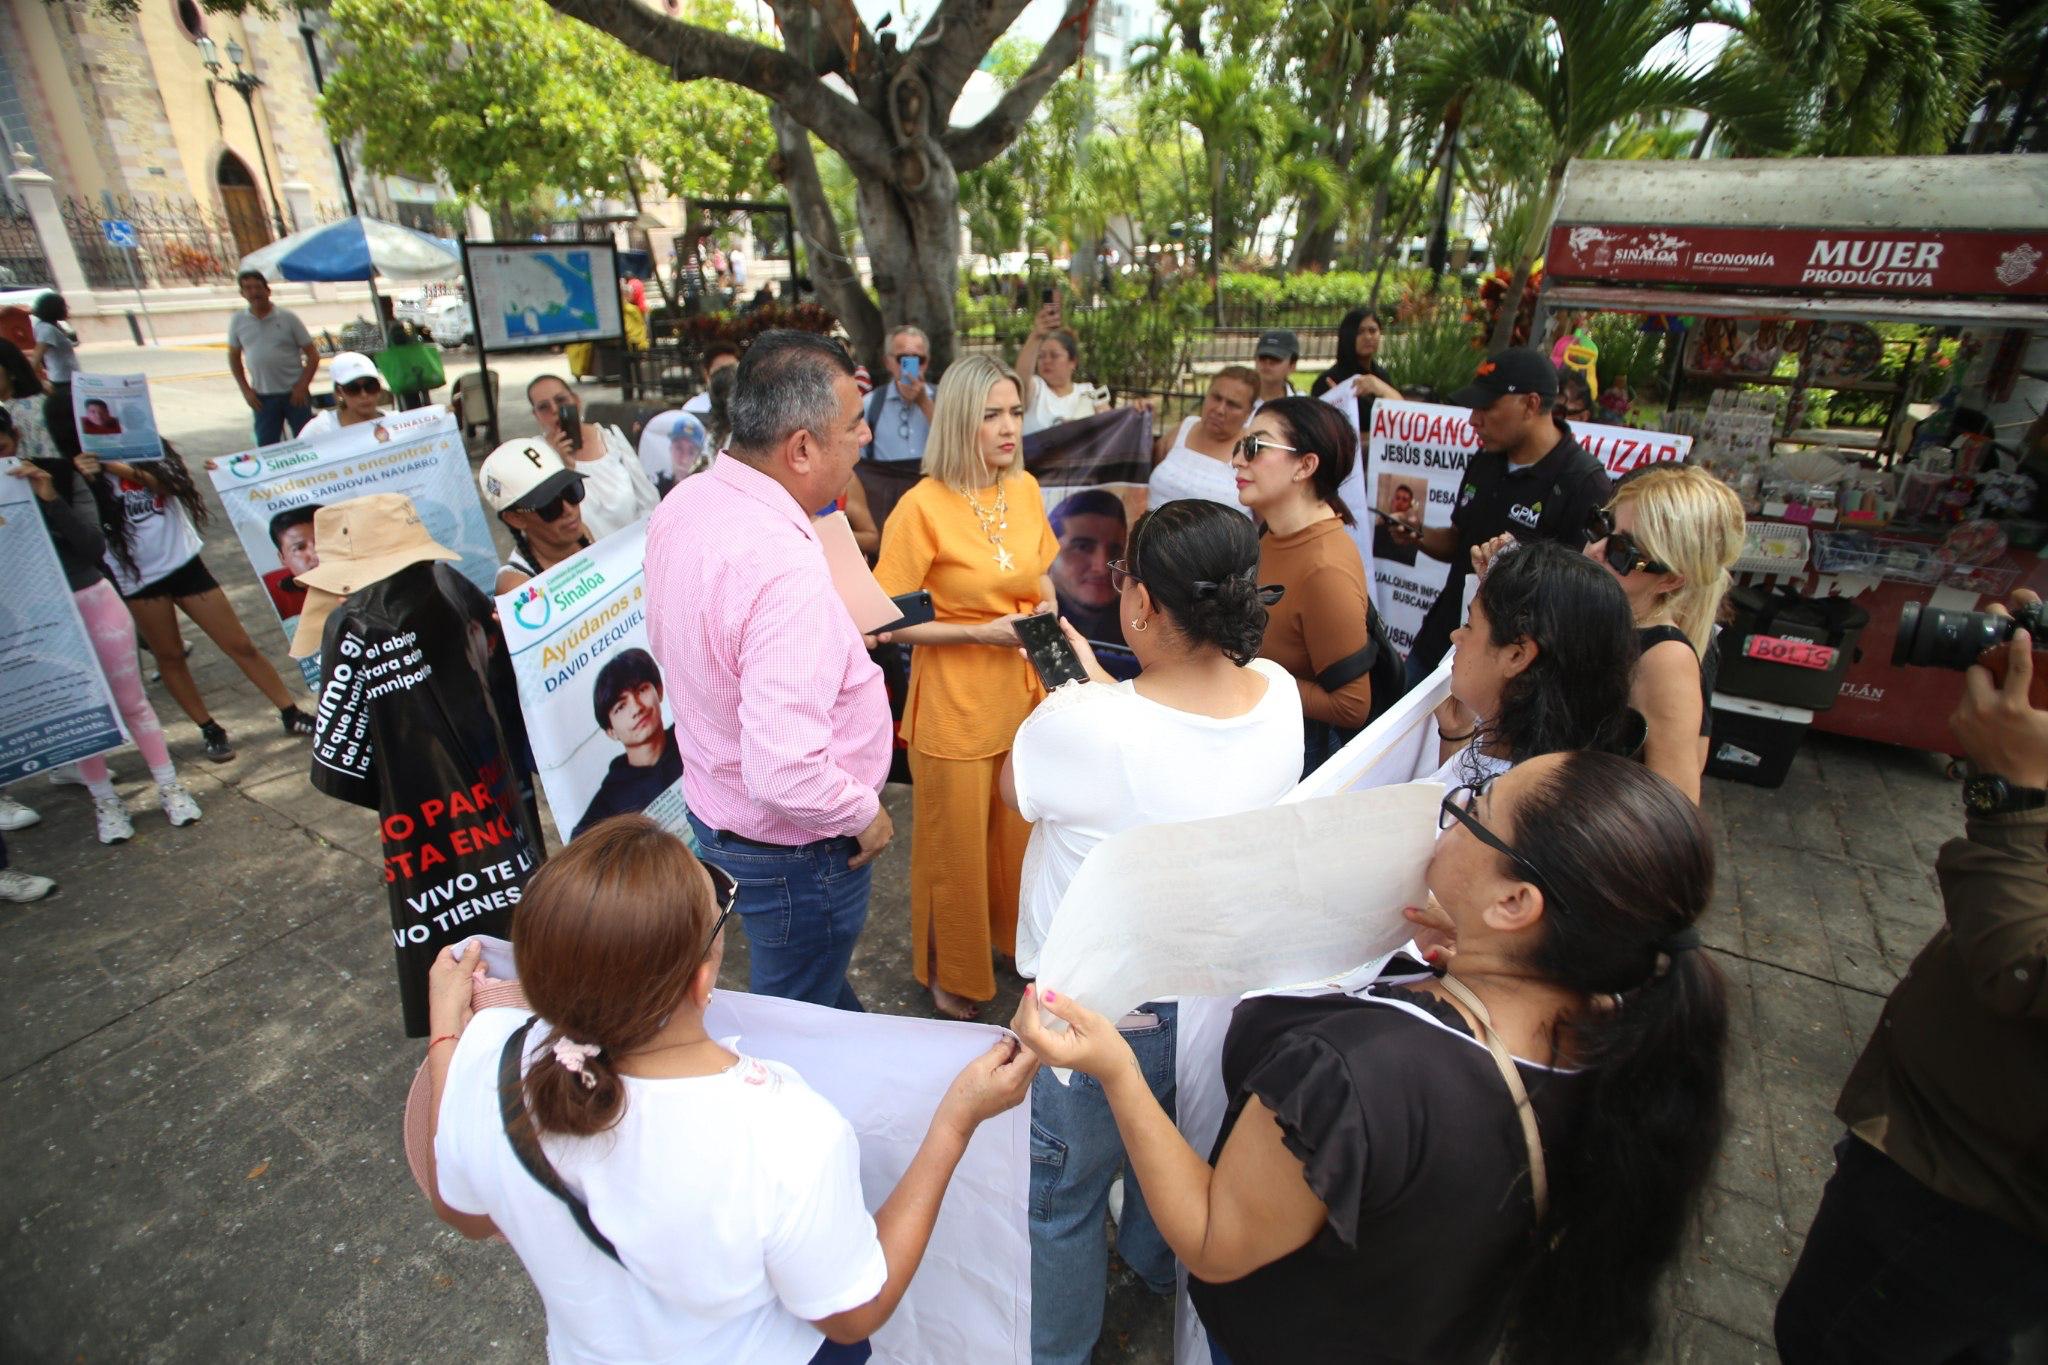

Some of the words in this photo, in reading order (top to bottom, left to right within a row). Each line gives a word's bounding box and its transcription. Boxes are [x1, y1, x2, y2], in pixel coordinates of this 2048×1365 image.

[1613, 248, 1679, 264] SINALOA
[1694, 252, 1775, 267] ECONOMÍA
[1809, 239, 1944, 269] MUJER
[1802, 267, 1934, 288] PRODUCTIVA
[391, 414, 440, 432] SINALOA
[266, 450, 319, 472] Sinaloa
[1381, 443, 1421, 466] JESÚS
[248, 469, 339, 503] Ayúdanos
[345, 466, 354, 476] a
[357, 444, 434, 471] encontrar
[267, 495, 310, 512] DAVID
[311, 475, 379, 499] SANDOVAL
[381, 457, 439, 480] NAVARRO
[1429, 488, 1457, 506] DESA
[554, 569, 605, 612] Sinaloa
[1375, 571, 1419, 591] UALQUIER
[543, 597, 629, 667] Ayúdanos
[1385, 625, 1414, 649] USEN
[366, 643, 380, 659] el
[544, 653, 589, 693] DAVID
[591, 611, 645, 658] EZEQUIEL
[1757, 639, 1827, 667] BOLIS
[1839, 682, 1885, 698] TLÁN
[320, 743, 336, 759] El
[330, 713, 352, 744] que
[341, 740, 360, 766] del
[356, 756, 371, 771] la
[420, 782, 494, 828] PAR
[407, 873, 478, 914] VIVO
[481, 860, 515, 885] TE
[433, 886, 523, 932] TIENES
